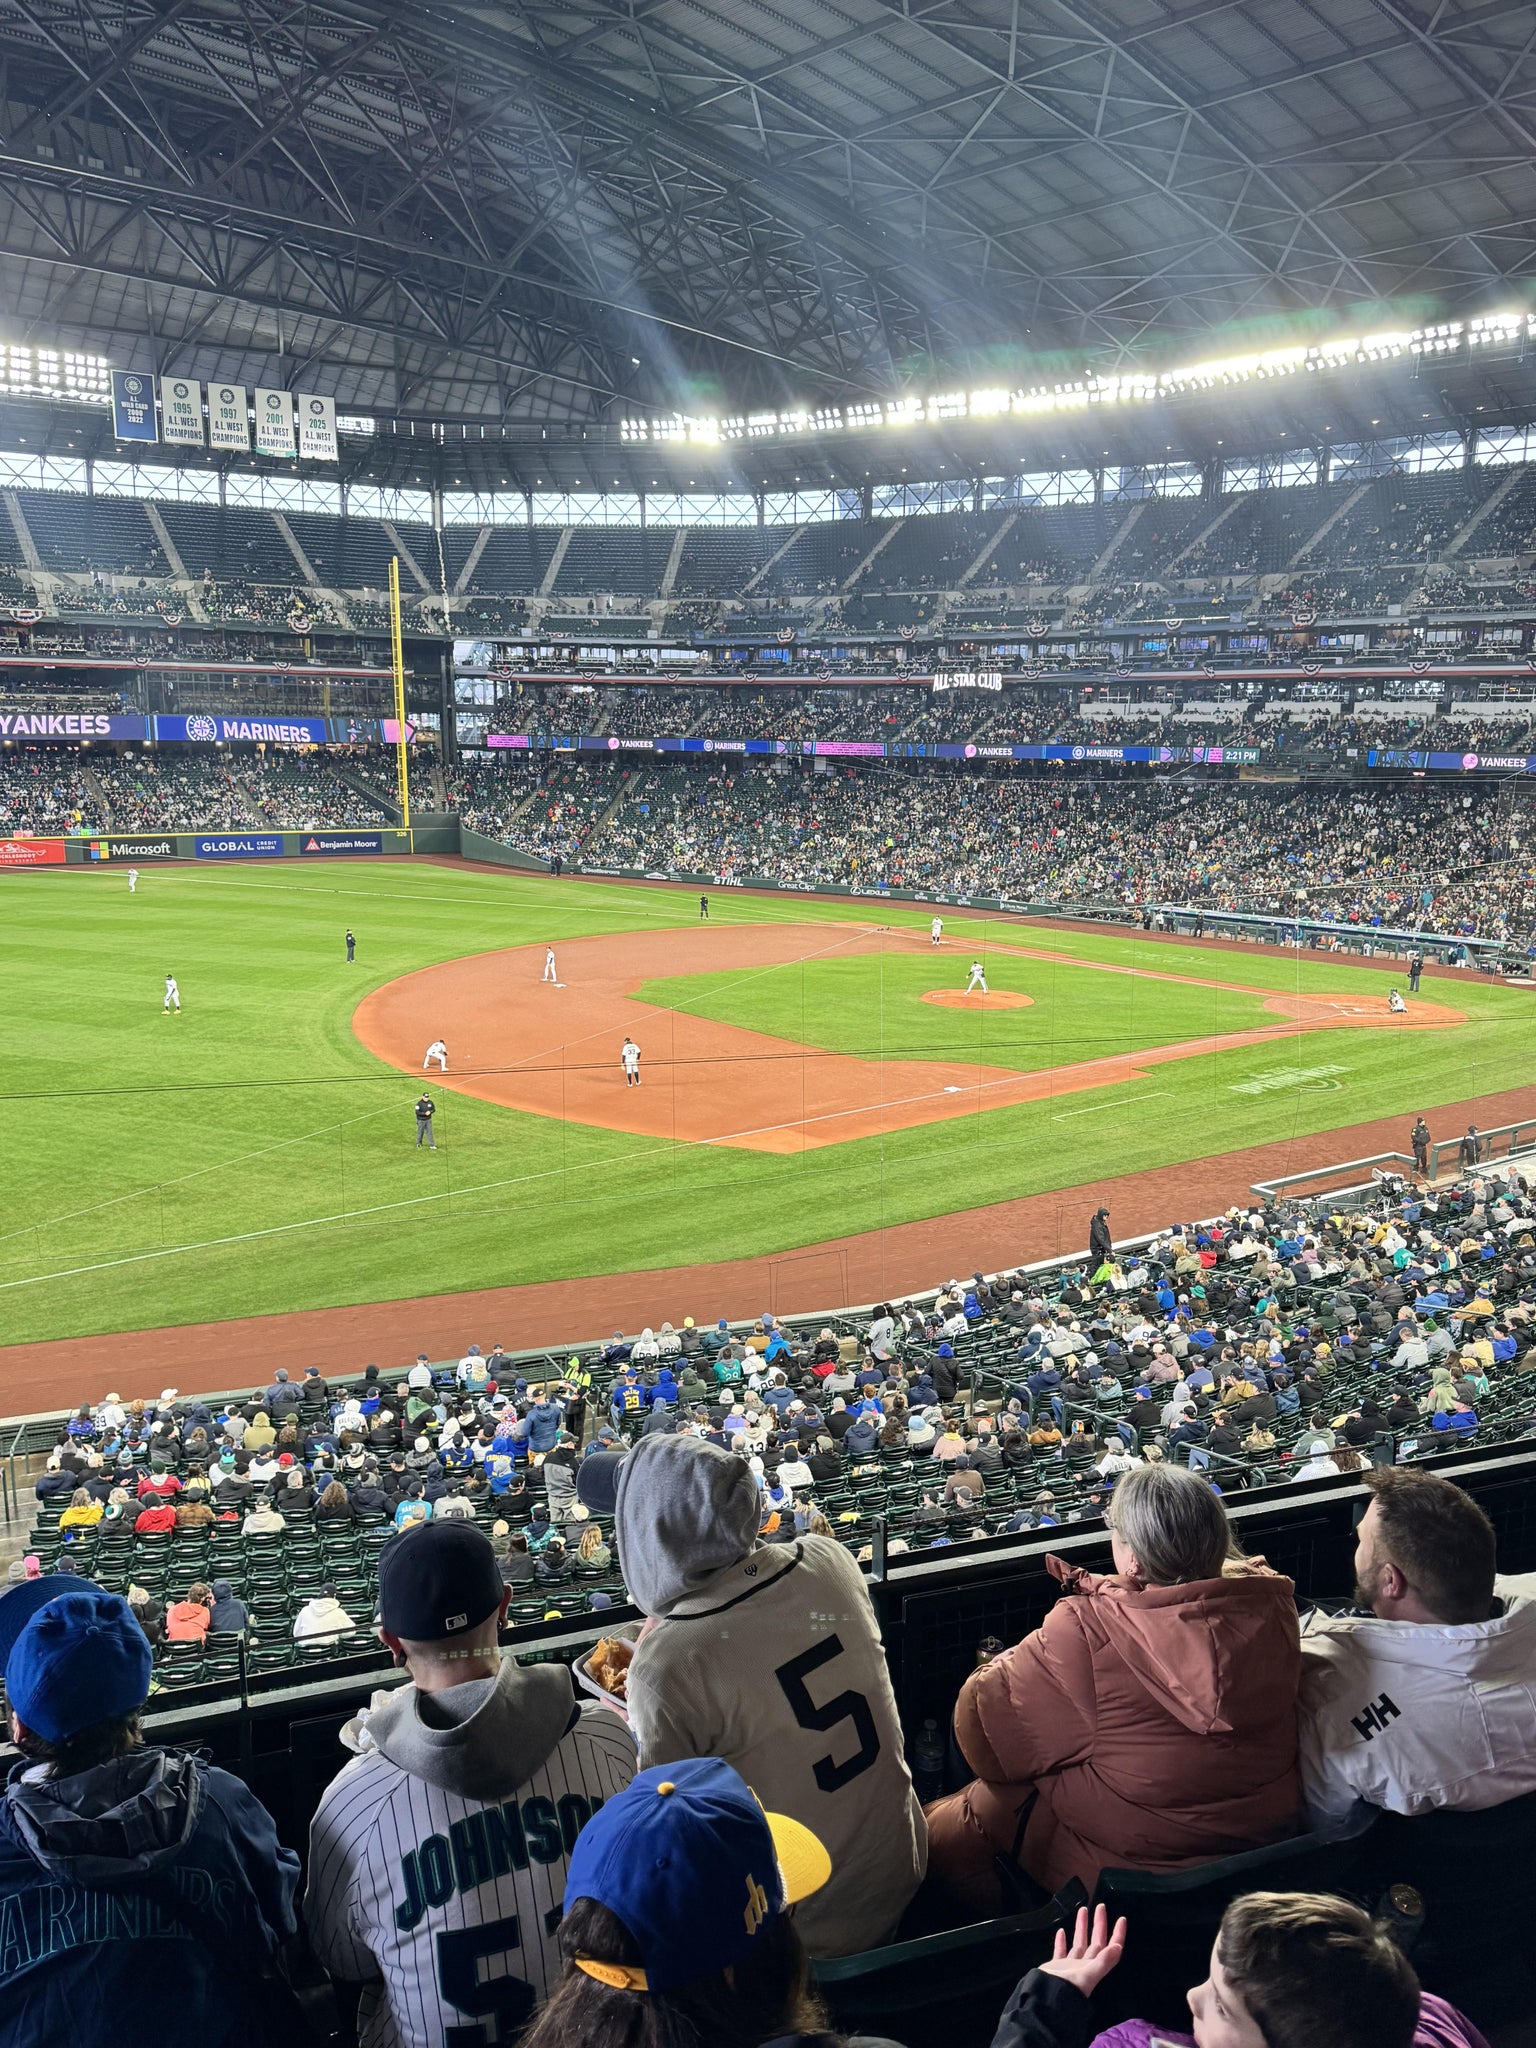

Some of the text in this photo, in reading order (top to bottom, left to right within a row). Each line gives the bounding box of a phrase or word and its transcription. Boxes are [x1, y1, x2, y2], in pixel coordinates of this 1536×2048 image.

[173, 402, 192, 414] 1995
[220, 408, 237, 419] 1997
[168, 416, 198, 427] A.L. WEST
[266, 413, 284, 425] 2001
[309, 418, 326, 430] 2025
[214, 421, 243, 432] A.L. WEST
[261, 426, 289, 437] A.L. WEST
[165, 427, 202, 440] CHAMPIONS
[211, 433, 248, 444] CHAMPIONS
[316, 432, 331, 442] WEST
[258, 437, 293, 449] CHAMPIONS
[302, 442, 335, 454] CHAMPIONS
[977, 673, 1002, 691] CLUB
[0, 715, 110, 735] YANKEES
[223, 720, 310, 743] MARINERS
[620, 740, 654, 748] YANKEES
[714, 742, 746, 750] MARINERS
[978, 747, 1013, 756] YANKEES
[1086, 749, 1124, 758] MARINERS
[1226, 751, 1242, 760] 2:21
[1243, 752, 1256, 761] PM
[1480, 757, 1527, 768] YANKEES
[112, 842, 171, 856] Microsoft
[202, 841, 254, 852] GLOBAL
[320, 840, 376, 850] Benjamin Moore
[713, 876, 744, 887] STIHL
[777, 880, 816, 892] Great Clips
[861, 889, 891, 897] LEXUS
[625, 1396, 639, 1410] 29
[774, 1633, 880, 1793] 5
[1349, 1692, 1402, 1742] HH
[396, 1793, 604, 1933] JOHNSO
